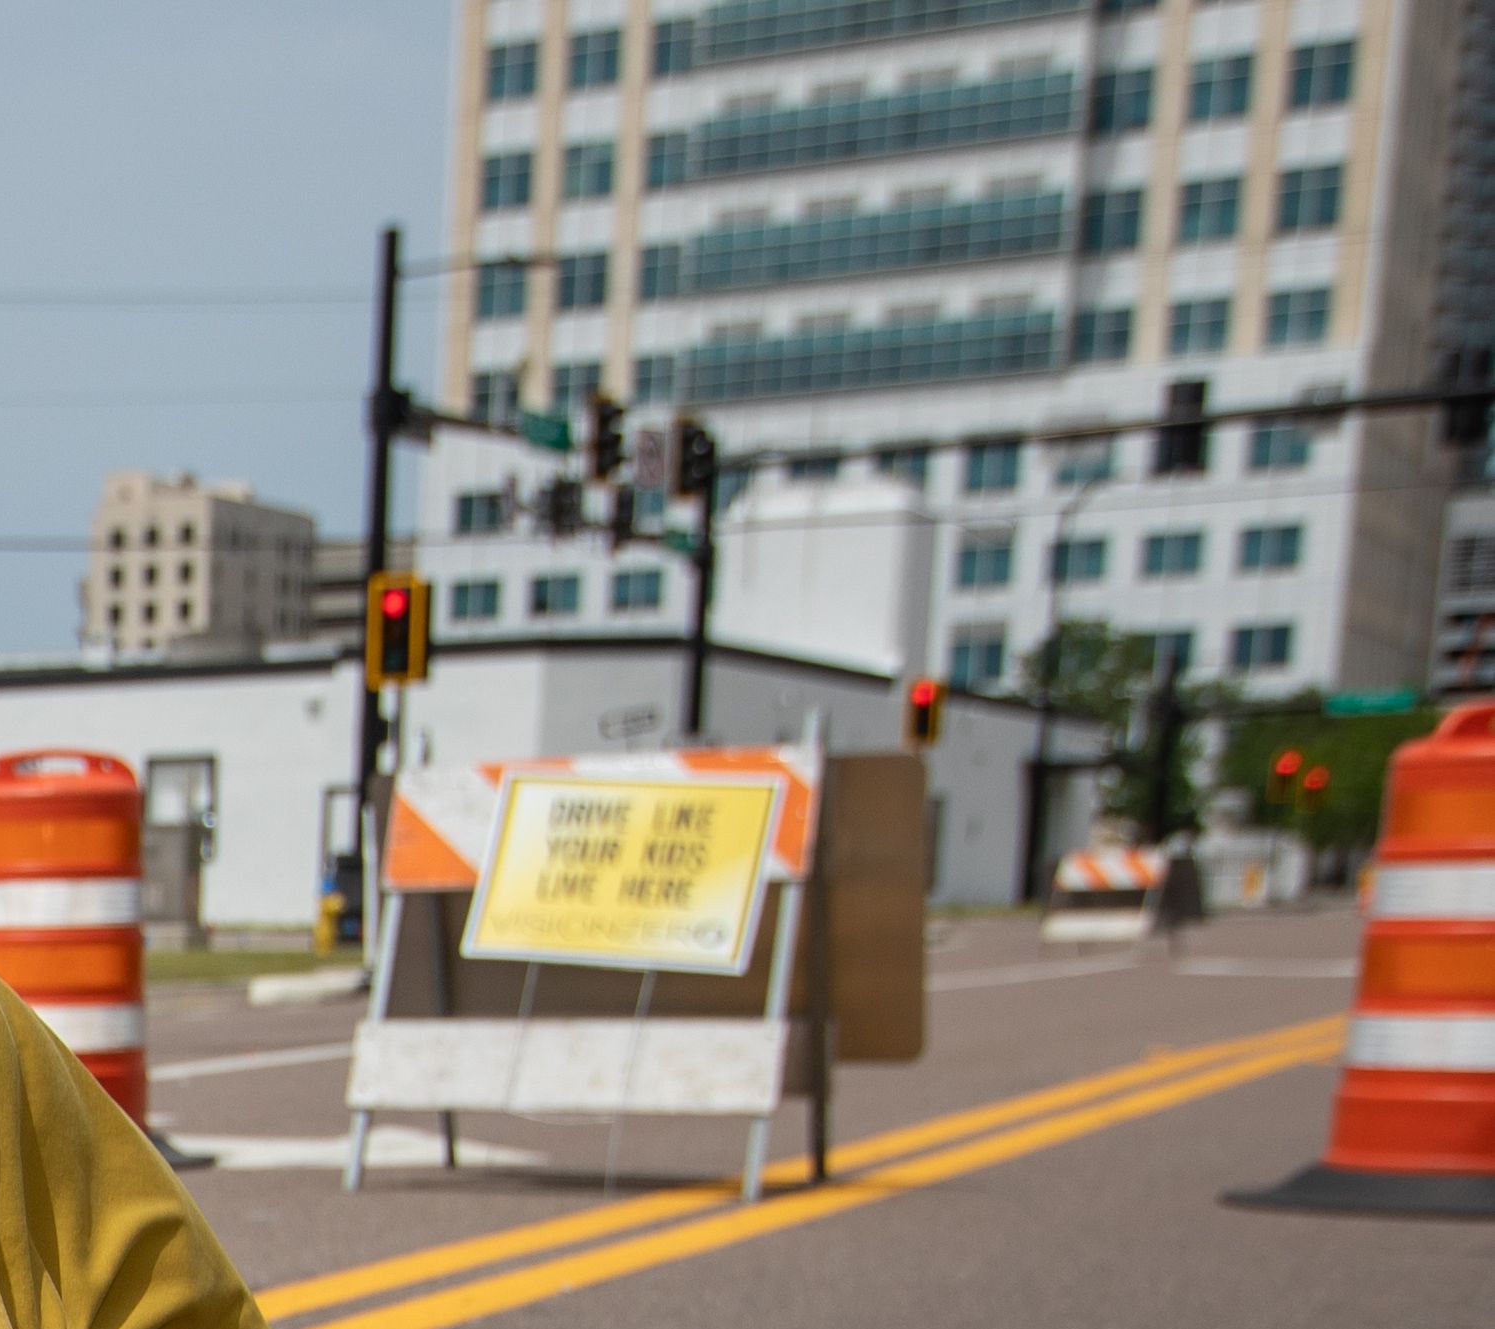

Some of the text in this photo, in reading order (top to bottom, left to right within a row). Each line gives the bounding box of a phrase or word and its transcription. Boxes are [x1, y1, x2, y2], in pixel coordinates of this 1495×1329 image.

[550, 797, 715, 833] DRIVE LIKE
[547, 836, 709, 873] YOUR KIDS
[536, 870, 693, 909] LIVE HERE
